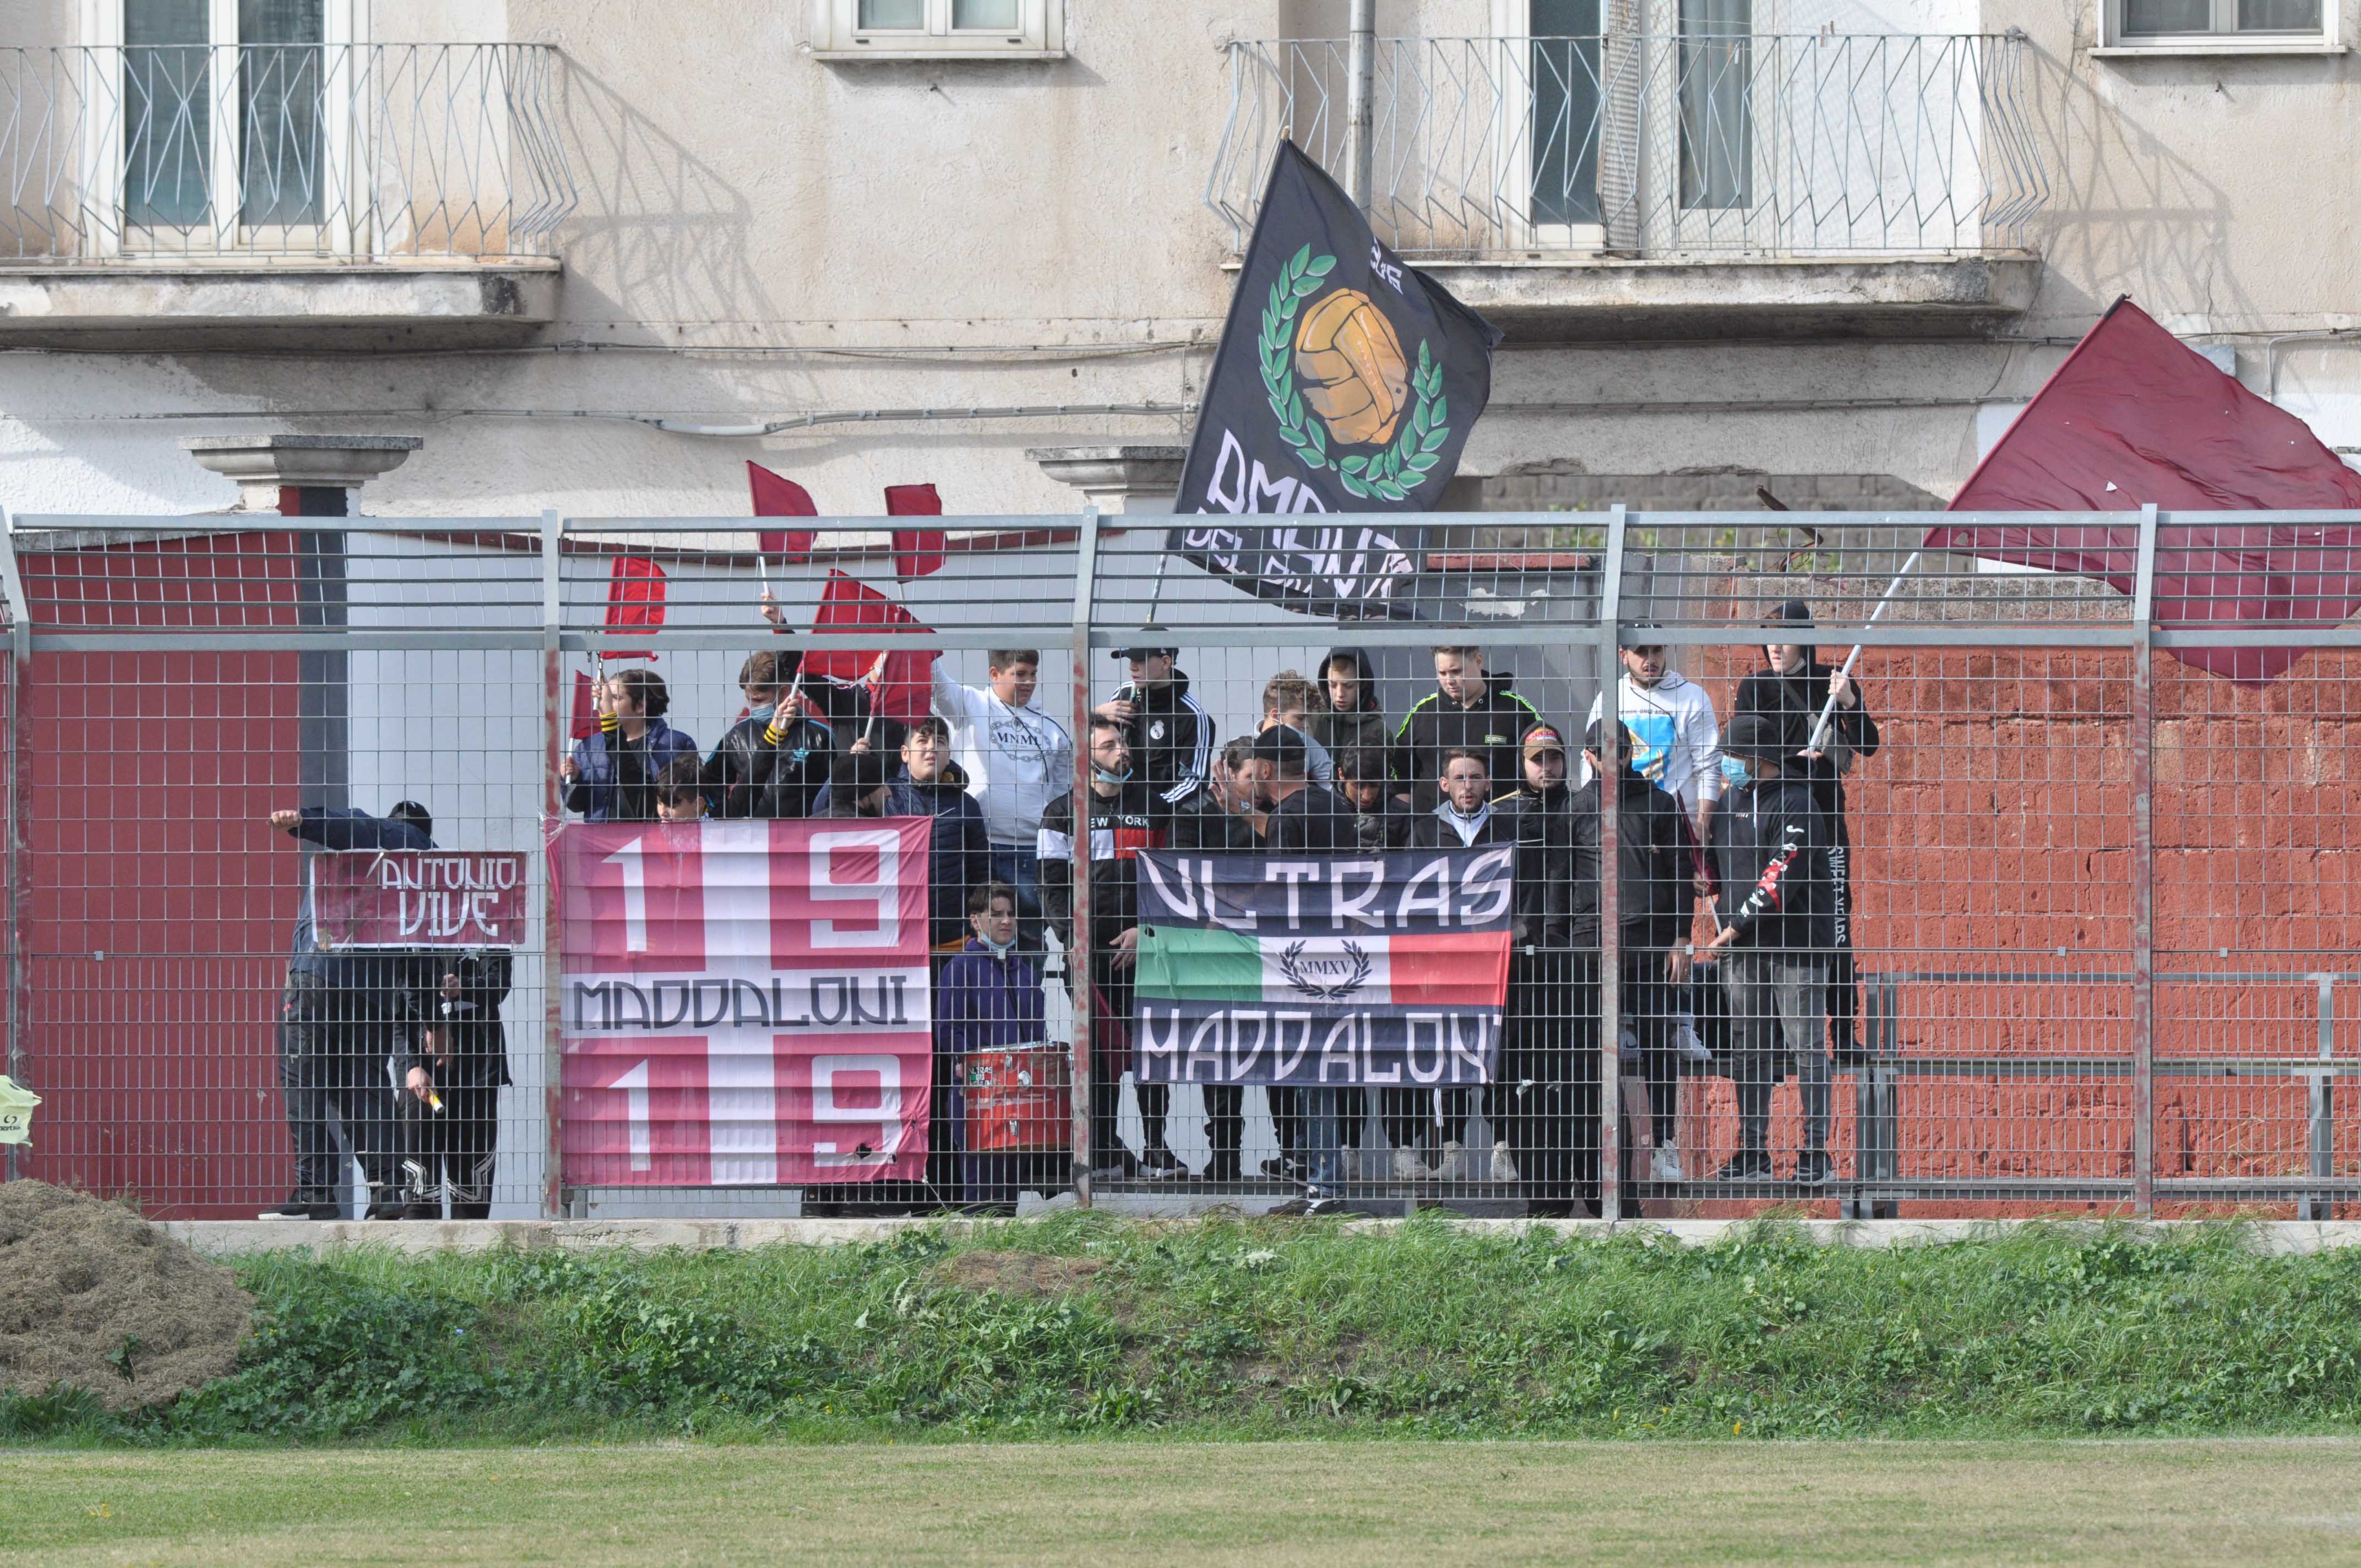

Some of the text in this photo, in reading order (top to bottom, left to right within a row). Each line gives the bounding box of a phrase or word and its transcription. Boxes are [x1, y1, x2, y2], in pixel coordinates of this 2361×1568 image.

[1090, 815, 1150, 827] EW YORK
[382, 858, 516, 890] ANTONIO
[399, 891, 499, 936] VIVE
[1299, 960, 1351, 975] MMXV
[573, 975, 909, 1031] MADDALONI
